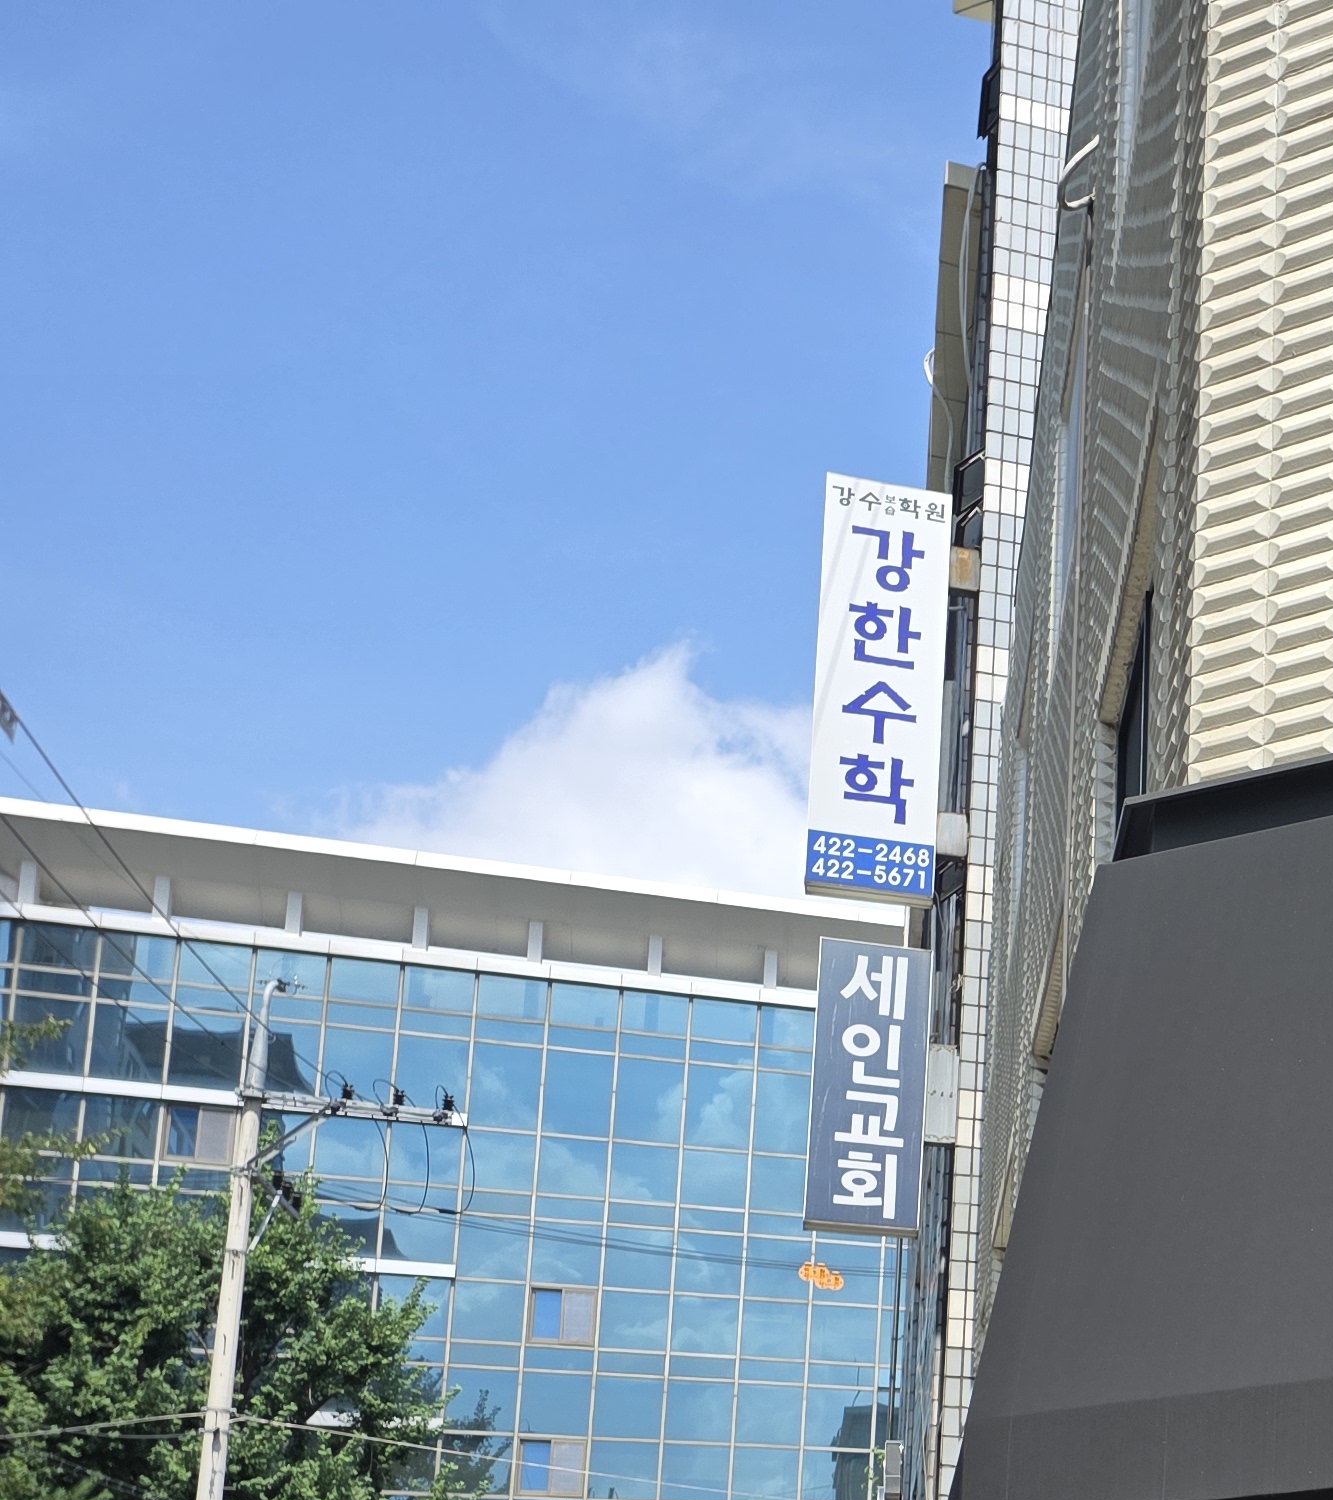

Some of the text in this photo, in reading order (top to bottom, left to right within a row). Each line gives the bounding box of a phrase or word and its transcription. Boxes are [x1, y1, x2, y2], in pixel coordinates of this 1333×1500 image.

[840, 525, 925, 825] 강한수학
[811, 857, 926, 890] 422-5671
[813, 835, 930, 868] 422-2468
[833, 955, 908, 1220] 세인교회
